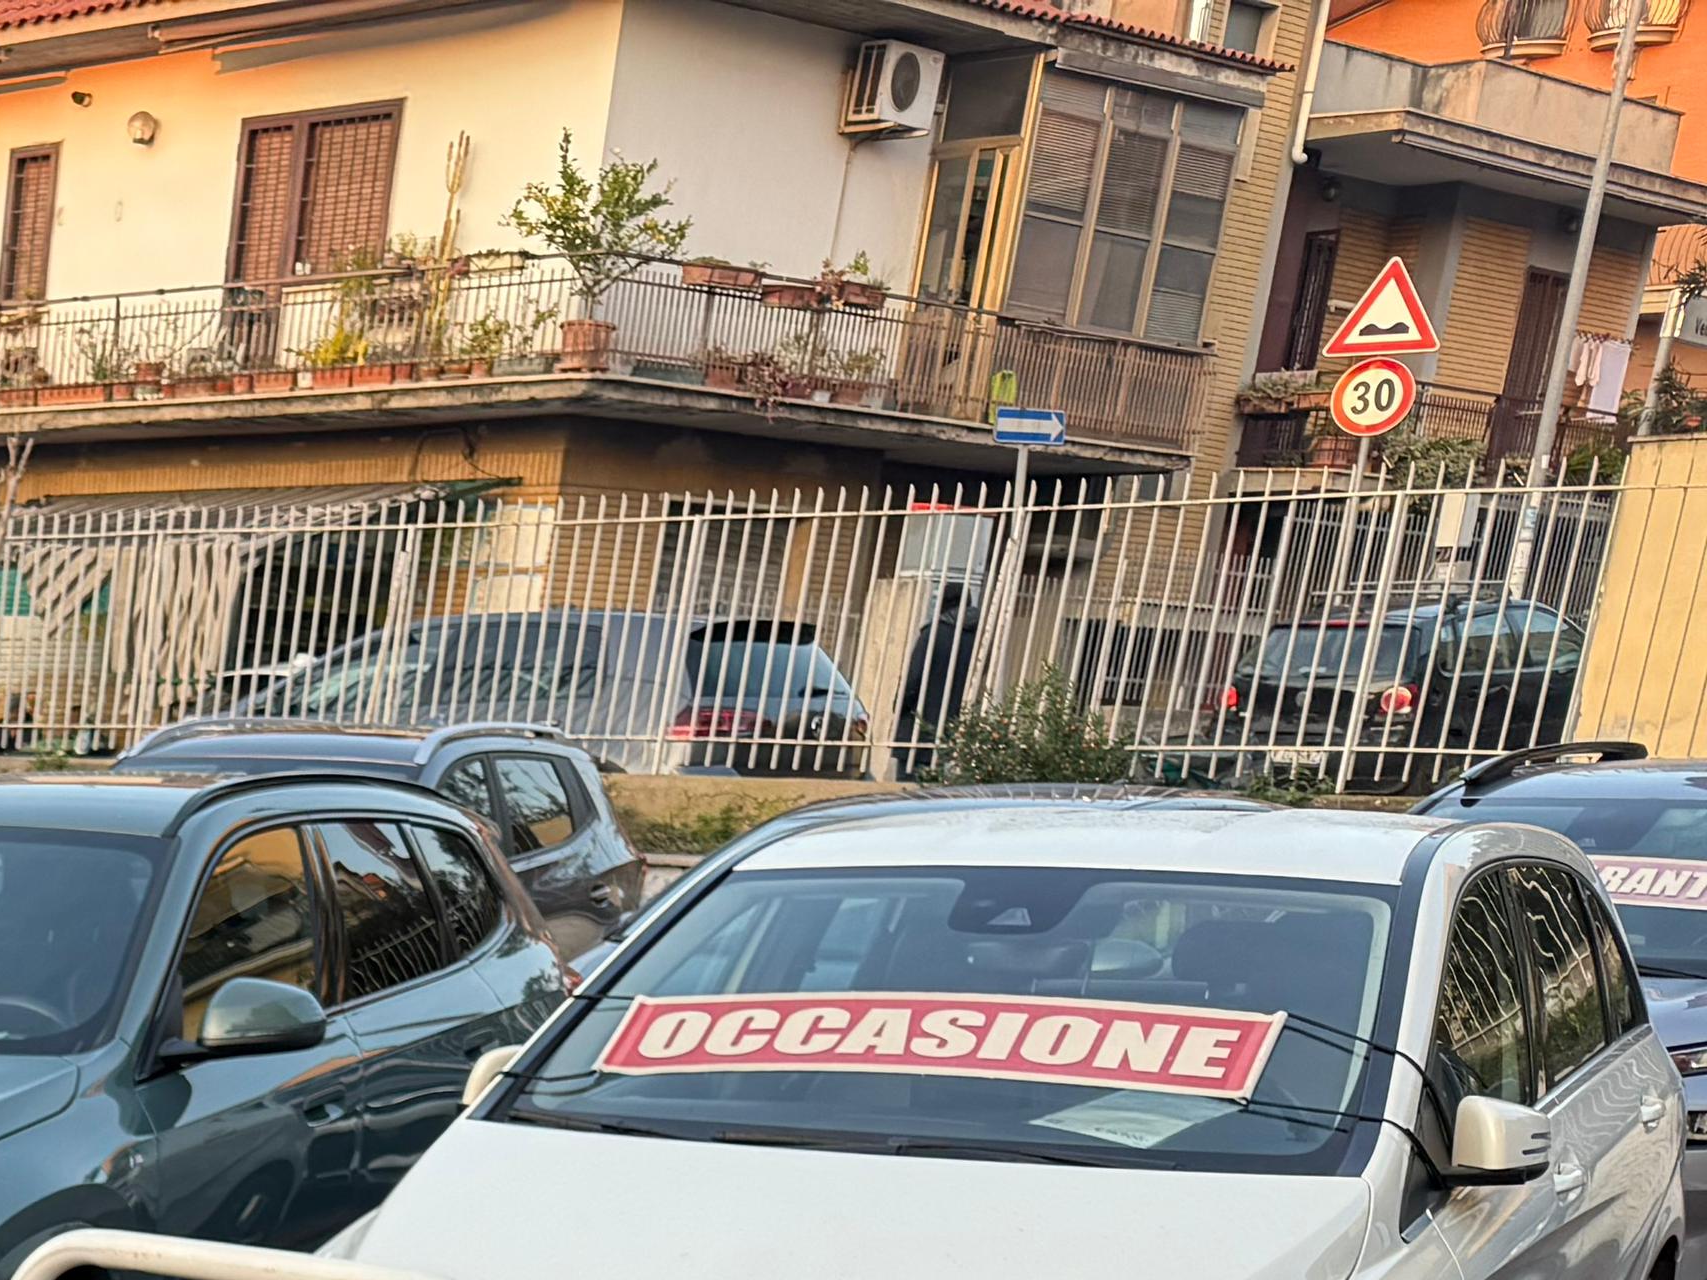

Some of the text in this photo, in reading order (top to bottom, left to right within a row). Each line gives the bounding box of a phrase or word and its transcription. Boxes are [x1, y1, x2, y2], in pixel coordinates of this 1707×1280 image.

[1350, 378, 1396, 415] 30
[1594, 865, 1707, 900] RANT
[638, 1006, 1244, 1079] OCCASIONE
